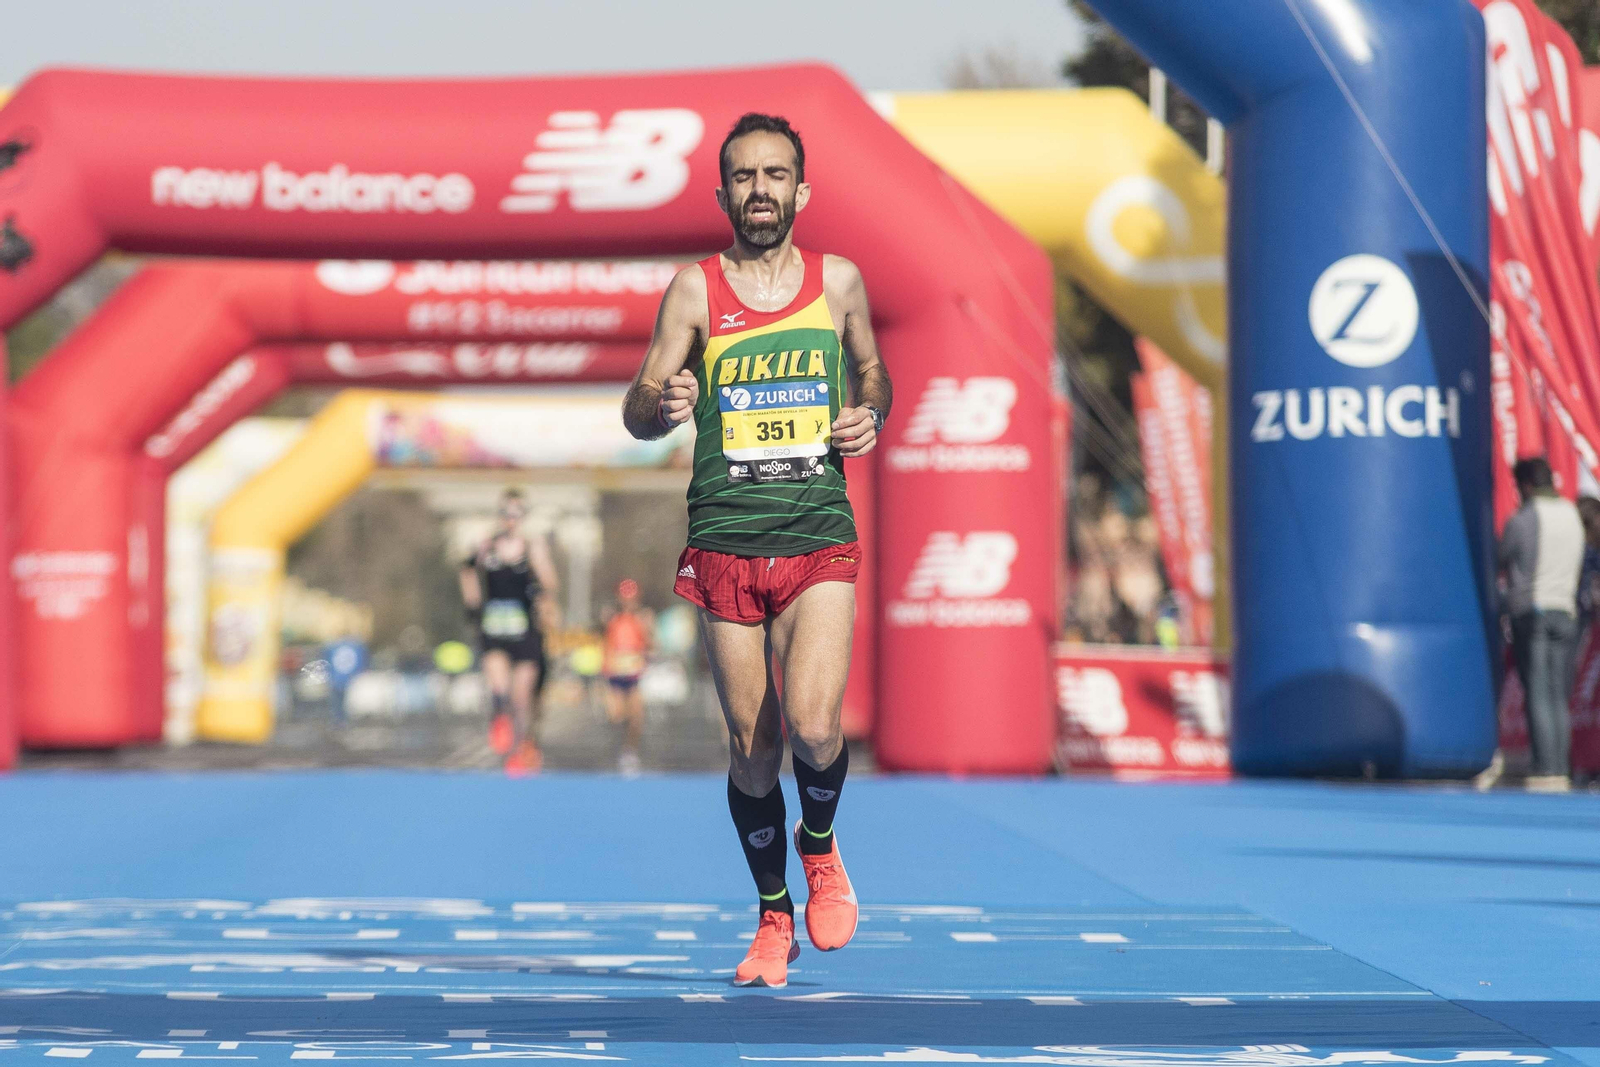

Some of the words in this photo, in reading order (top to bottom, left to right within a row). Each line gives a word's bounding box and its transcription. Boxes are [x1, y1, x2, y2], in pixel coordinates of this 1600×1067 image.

[152, 165, 259, 209] new
[262, 160, 475, 213] balance
[718, 350, 828, 385] BIKILA
[755, 389, 816, 405] ZURICH
[1250, 384, 1461, 442] ZURICH
[757, 419, 795, 441] 351
[764, 448, 790, 457] DIEGO
